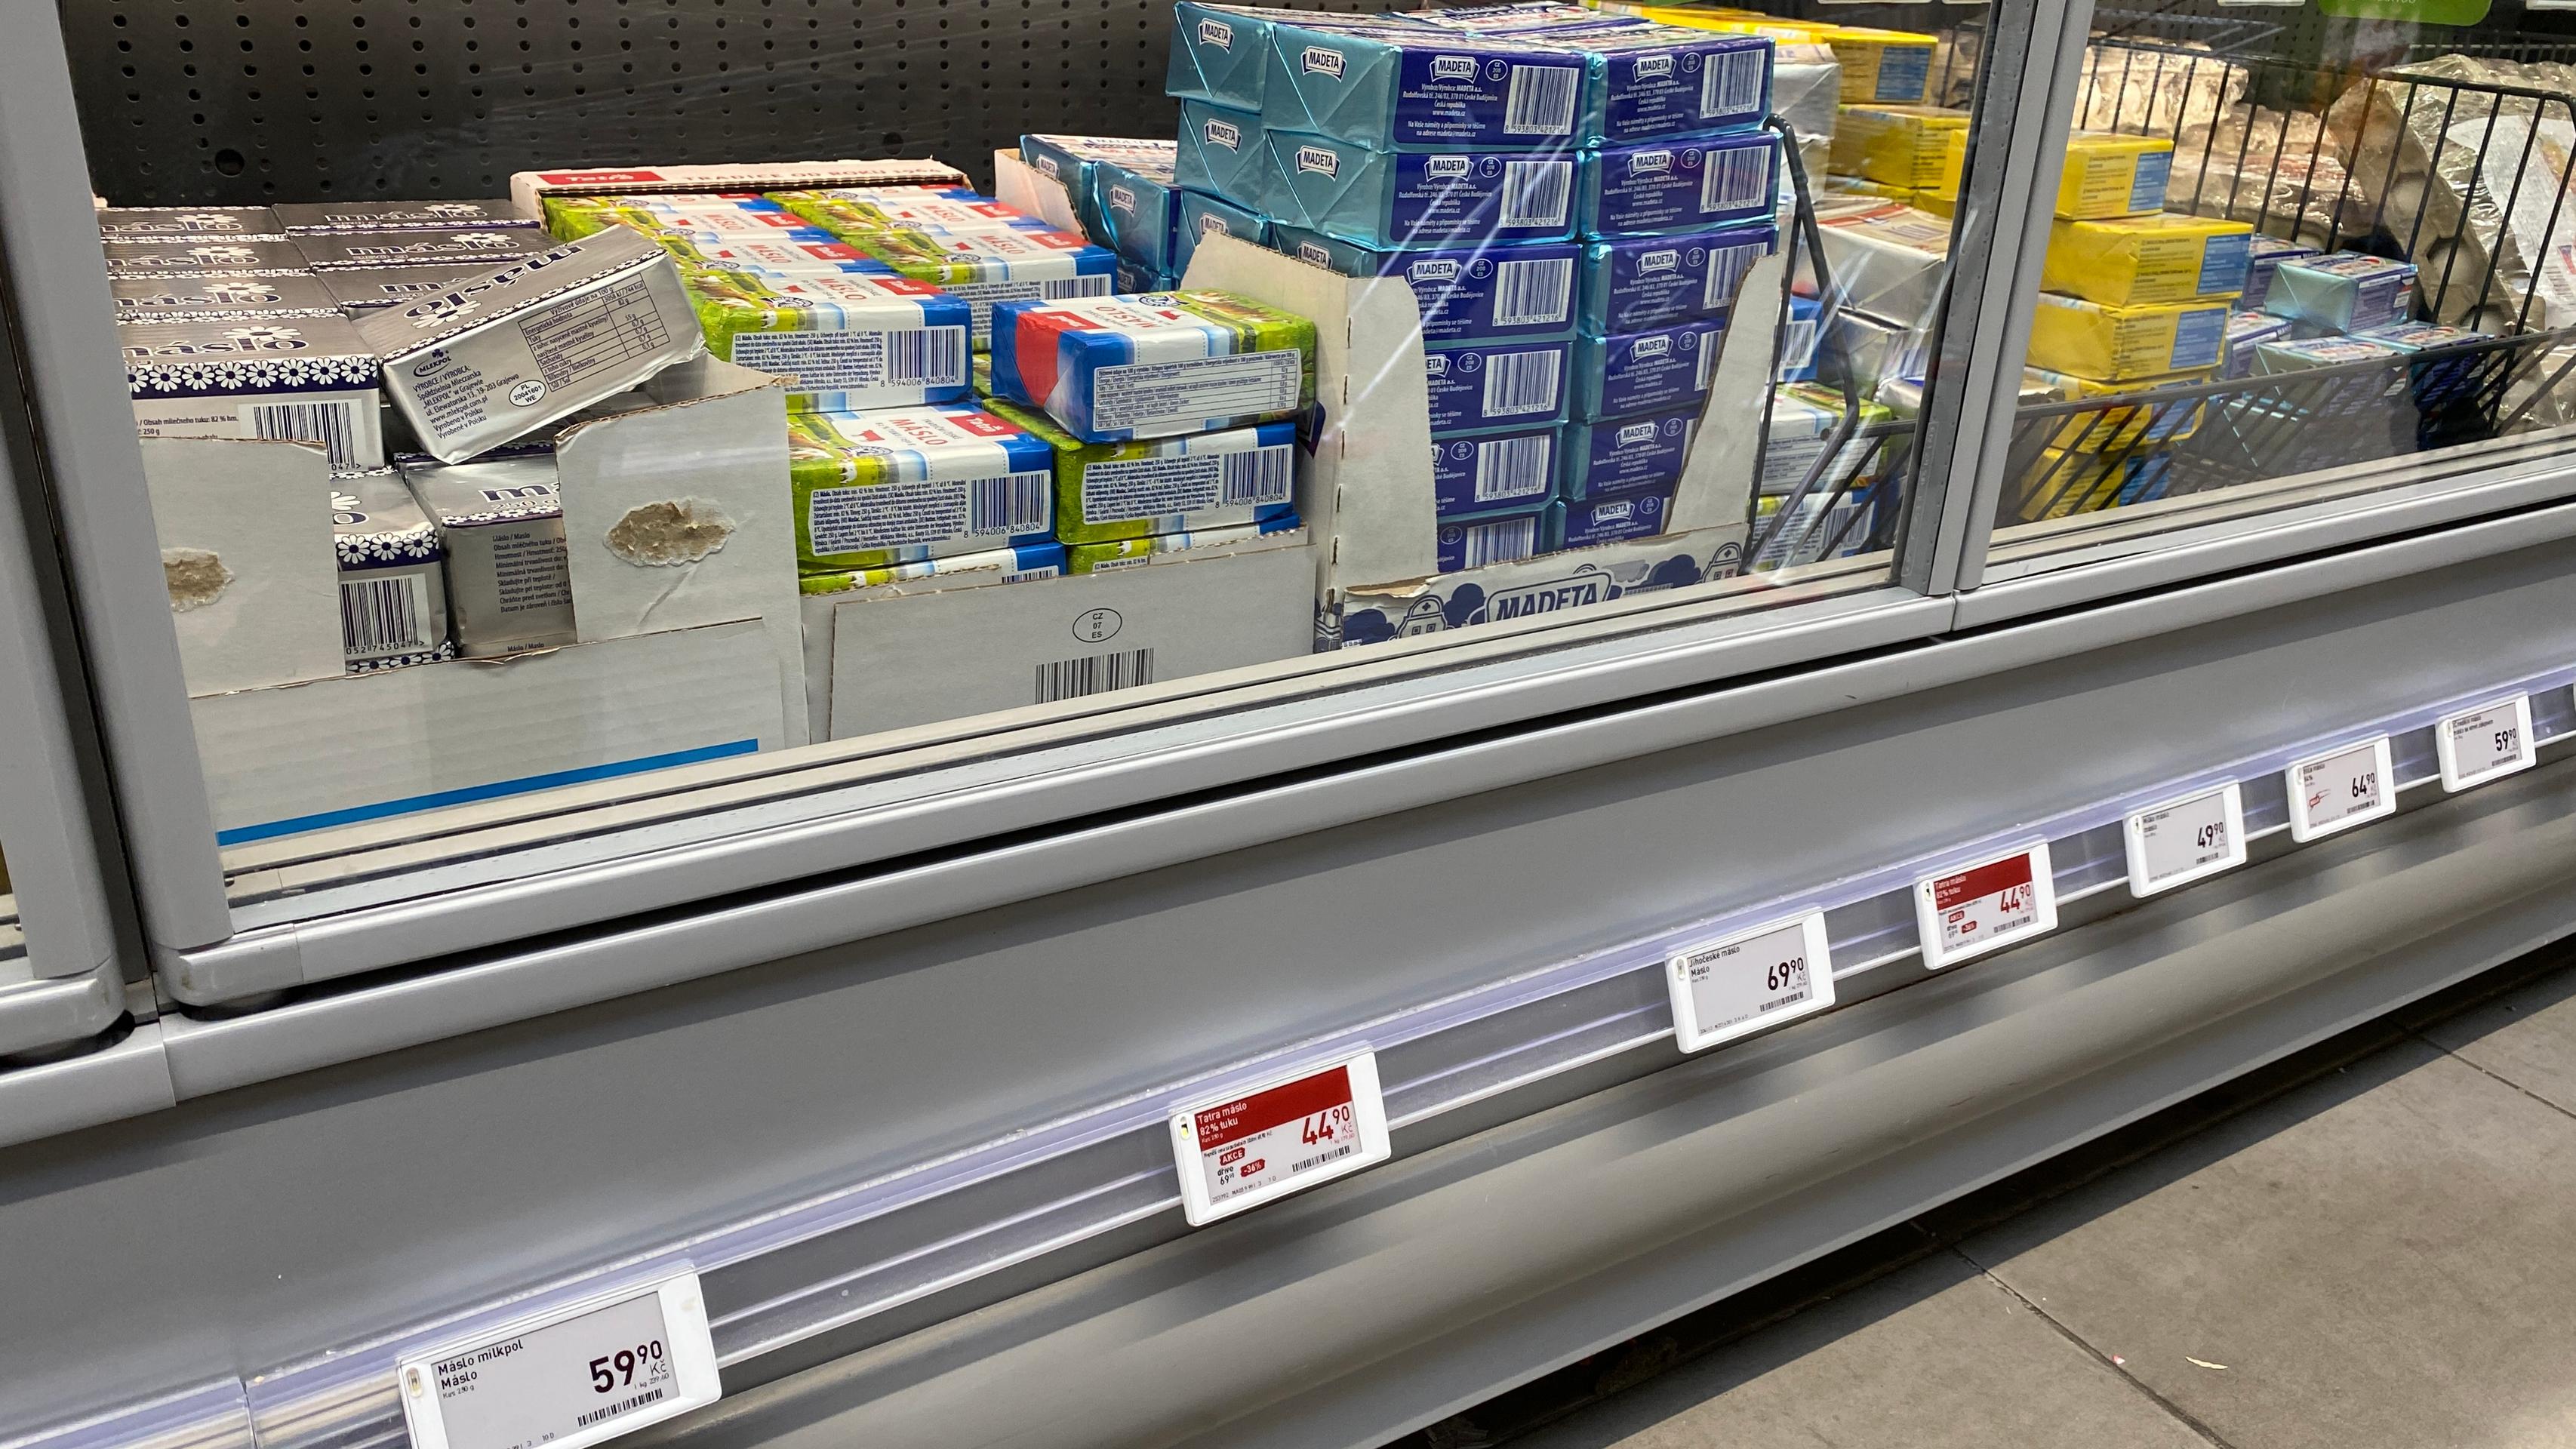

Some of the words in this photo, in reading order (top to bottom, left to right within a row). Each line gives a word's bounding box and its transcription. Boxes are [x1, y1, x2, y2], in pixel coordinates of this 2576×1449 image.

[1204, 22, 1229, 43] MADETA
[1309, 51, 1339, 69] MADETA
[1438, 60, 1472, 73] MADETA
[1640, 58, 1670, 71] MADETA
[1211, 123, 1236, 144] MADETA
[1303, 150, 1334, 169] MADETA
[1433, 161, 1466, 171] MADETA
[1636, 155, 1667, 167] MADETA
[1114, 191, 1133, 206] MADETA
[325, 209, 488, 221] máslo
[346, 240, 520, 256] máslo
[1303, 246, 1326, 264] MADETA
[1644, 254, 1673, 266] MADETA
[1416, 263, 1453, 275] MADETA
[404, 245, 586, 319] máslo
[1503, 316, 1530, 325] 593803
[1533, 314, 1559, 323] 421216
[1638, 339, 1666, 352] MADETA
[419, 356, 451, 374] MLEKPOL
[413, 378, 439, 392] VÝROBCE
[442, 365, 471, 381] VÝROBCA:
[452, 371, 482, 387] Mleczarska
[460, 379, 484, 394] Grajewie
[892, 379, 922, 387] 594006
[435, 395, 467, 414] Elewatorska
[497, 374, 519, 388] Grajewo
[513, 385, 543, 401] 20041601
[525, 395, 537, 404] WE
[430, 395, 488, 424] www.mlekpol.com.pl
[1492, 406, 1519, 415] 593803
[1522, 404, 1547, 413] 421216
[433, 417, 460, 432] Vyrobeno
[465, 408, 483, 419] Polsku
[468, 415, 487, 426] Polsku
[1623, 425, 1652, 438] MADETA
[1225, 497, 1252, 507] 594006
[1256, 494, 1283, 504] 840804
[1599, 503, 1627, 516] MADETA
[964, 531, 968, 539] 8
[974, 527, 1006, 537] 594006
[1010, 523, 1040, 534] 840804
[1496, 583, 1597, 621] MADETA
[372, 641, 412, 651] 745047
[2494, 731, 2509, 752] 59
[2352, 776, 2367, 797] 64
[2197, 825, 2214, 848] 49
[2214, 822, 2224, 835] 90
[2020, 884, 2030, 899] 90
[2001, 888, 2020, 913] 44
[1689, 952, 1720, 968] Jihočeské
[1722, 946, 1740, 958] máslo
[1790, 957, 1804, 974] 90
[1768, 962, 1790, 991] 69
[1197, 1109, 1221, 1124] Tatra
[1222, 1100, 1248, 1117] máslo
[1332, 1106, 1350, 1124] 90
[1199, 1123, 1219, 1137] 82%
[1220, 1116, 1239, 1130] tuku
[1302, 1111, 1334, 1145] 44
[1341, 1122, 1353, 1133] Kč
[1223, 1150, 1243, 1163] AKCE
[1243, 1162, 1262, 1174] -36%
[1220, 1174, 1229, 1186] 69
[437, 1354, 475, 1376] Máslo
[476, 1339, 524, 1364] milkpol
[636, 1340, 663, 1364] 90
[588, 1349, 636, 1394] 59
[649, 1359, 666, 1375] Kč
[440, 1369, 478, 1390] Máslo
[442, 1389, 456, 1398] Kus
